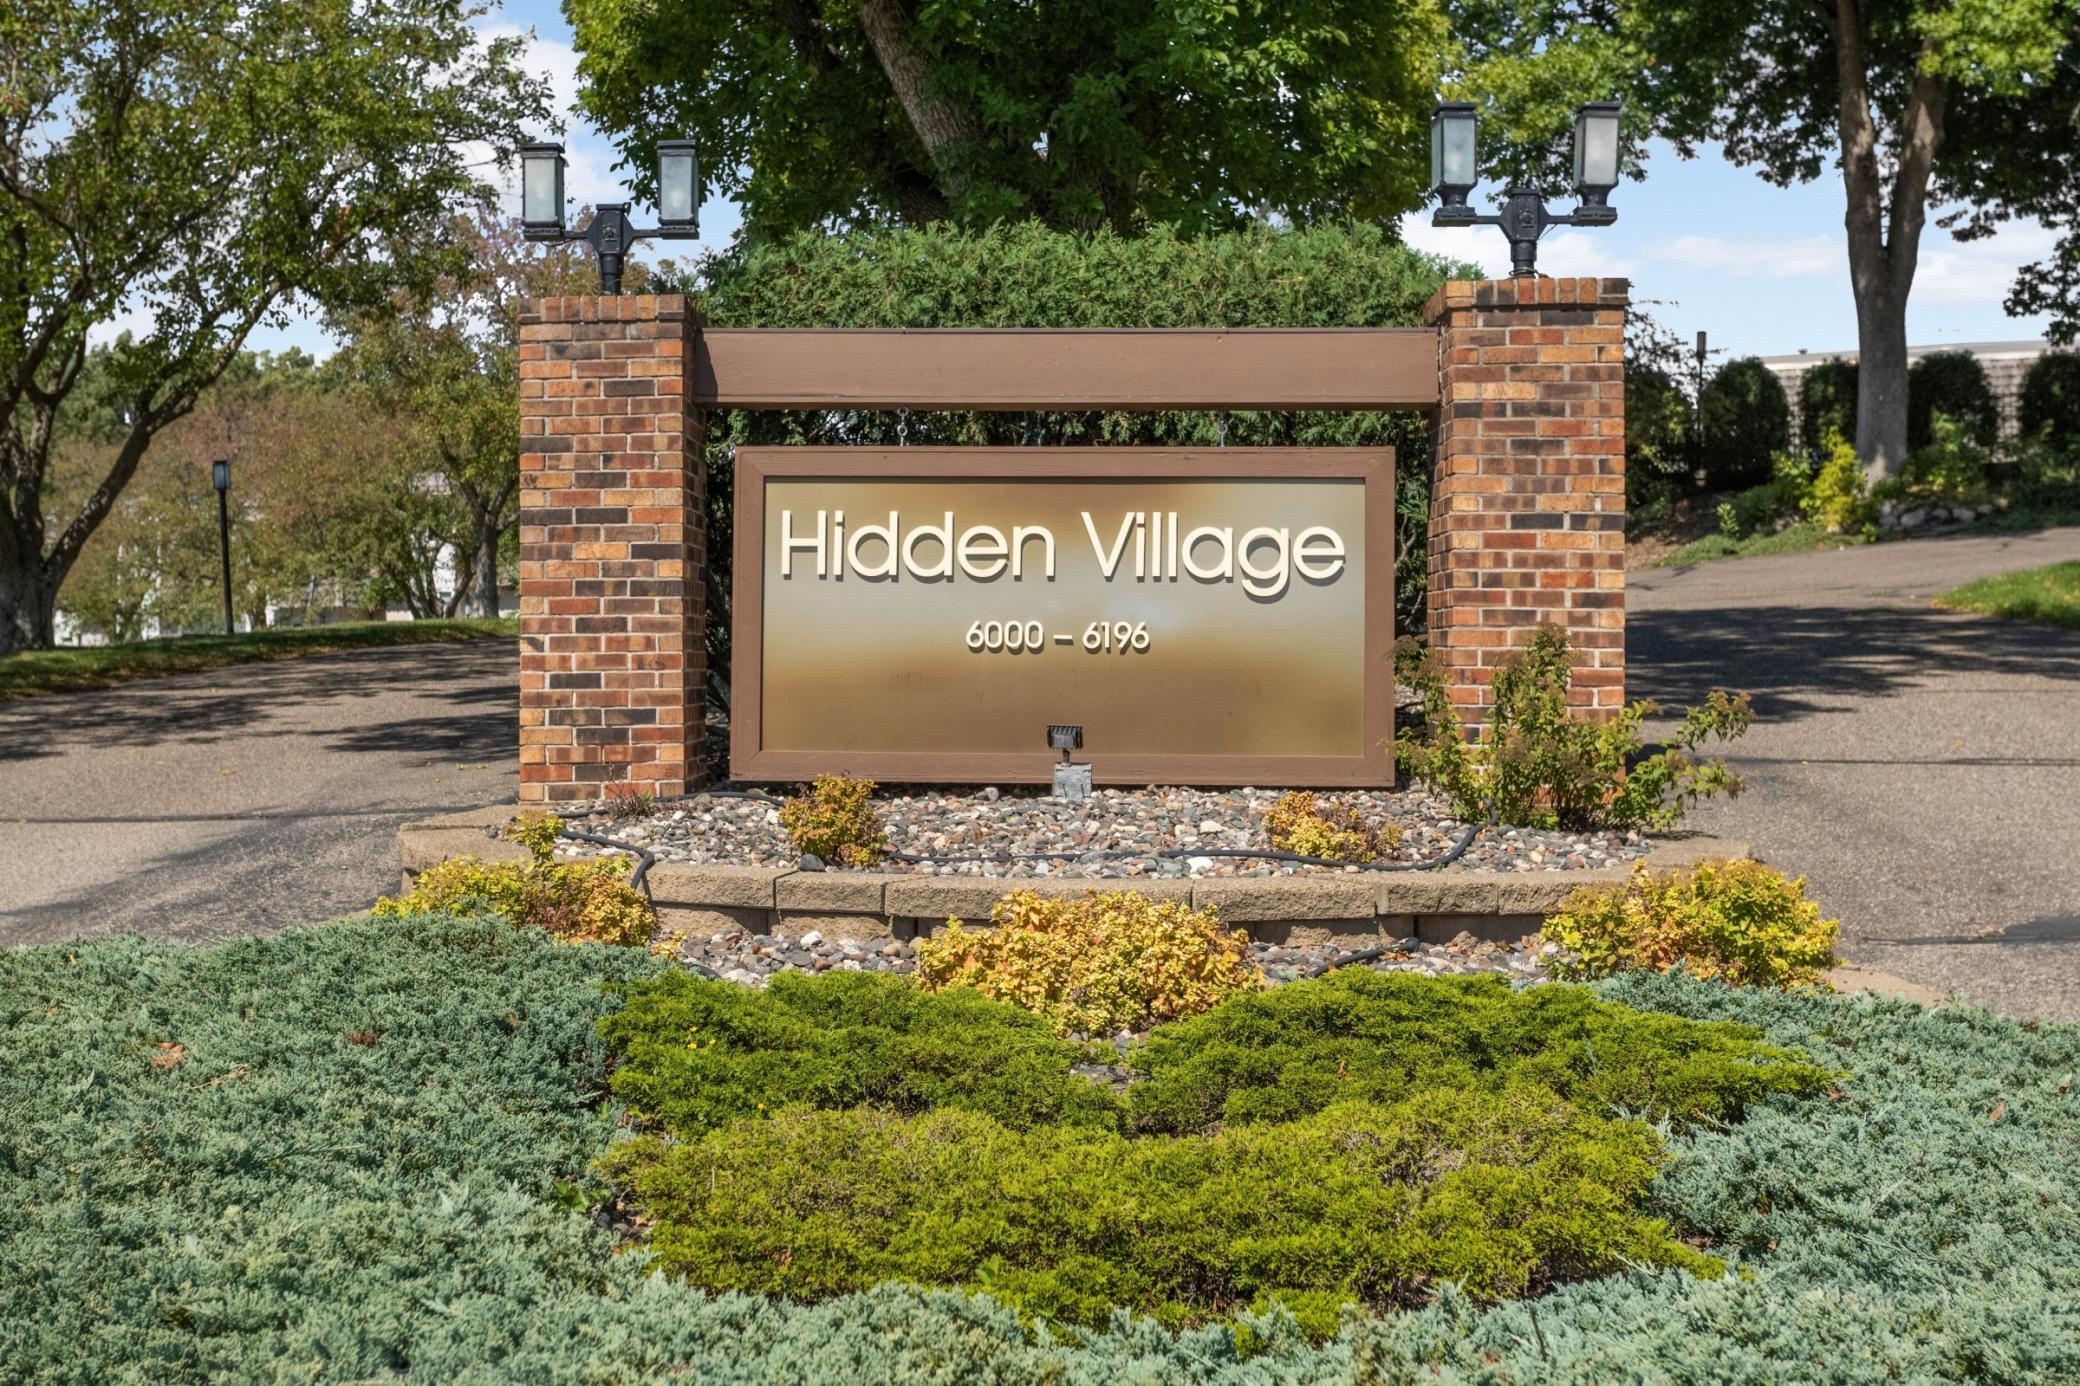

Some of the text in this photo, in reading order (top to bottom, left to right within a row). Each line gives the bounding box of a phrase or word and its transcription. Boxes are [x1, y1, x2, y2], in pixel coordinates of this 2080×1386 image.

[780, 510, 1346, 597] Hidden Village
[965, 620, 1044, 649] 6000
[1081, 621, 1150, 650] 6196
